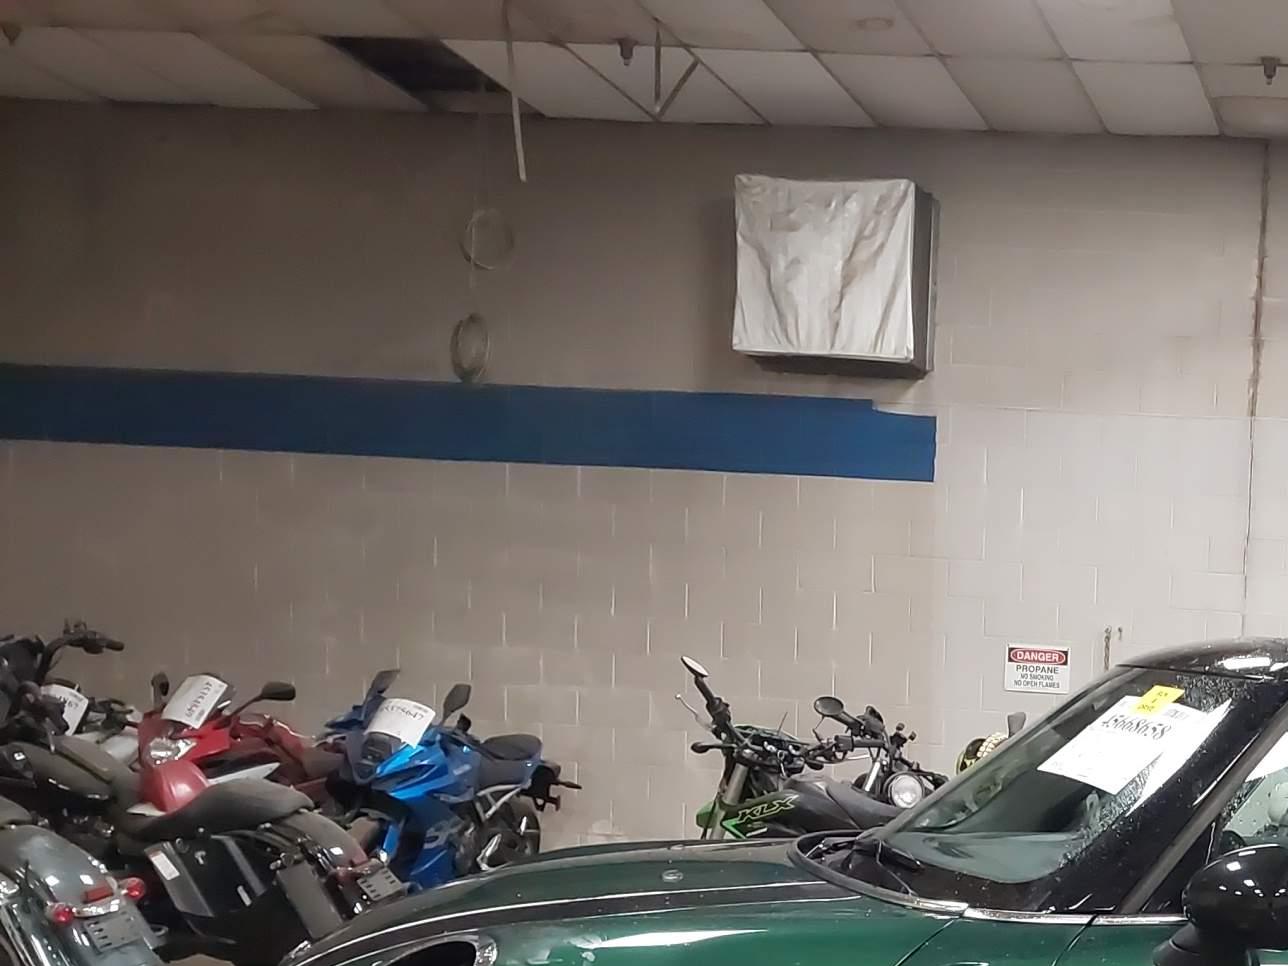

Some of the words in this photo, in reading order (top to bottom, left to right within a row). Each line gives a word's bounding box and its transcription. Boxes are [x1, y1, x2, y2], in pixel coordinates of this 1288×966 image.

[1016, 651, 1059, 662] DANGER
[1016, 665, 1060, 674] PROPANE
[1023, 680, 1038, 688] OPEN
[1039, 681, 1060, 689] FLAMES
[1101, 714, 1172, 741] 45668658
[736, 793, 800, 824] KLX
